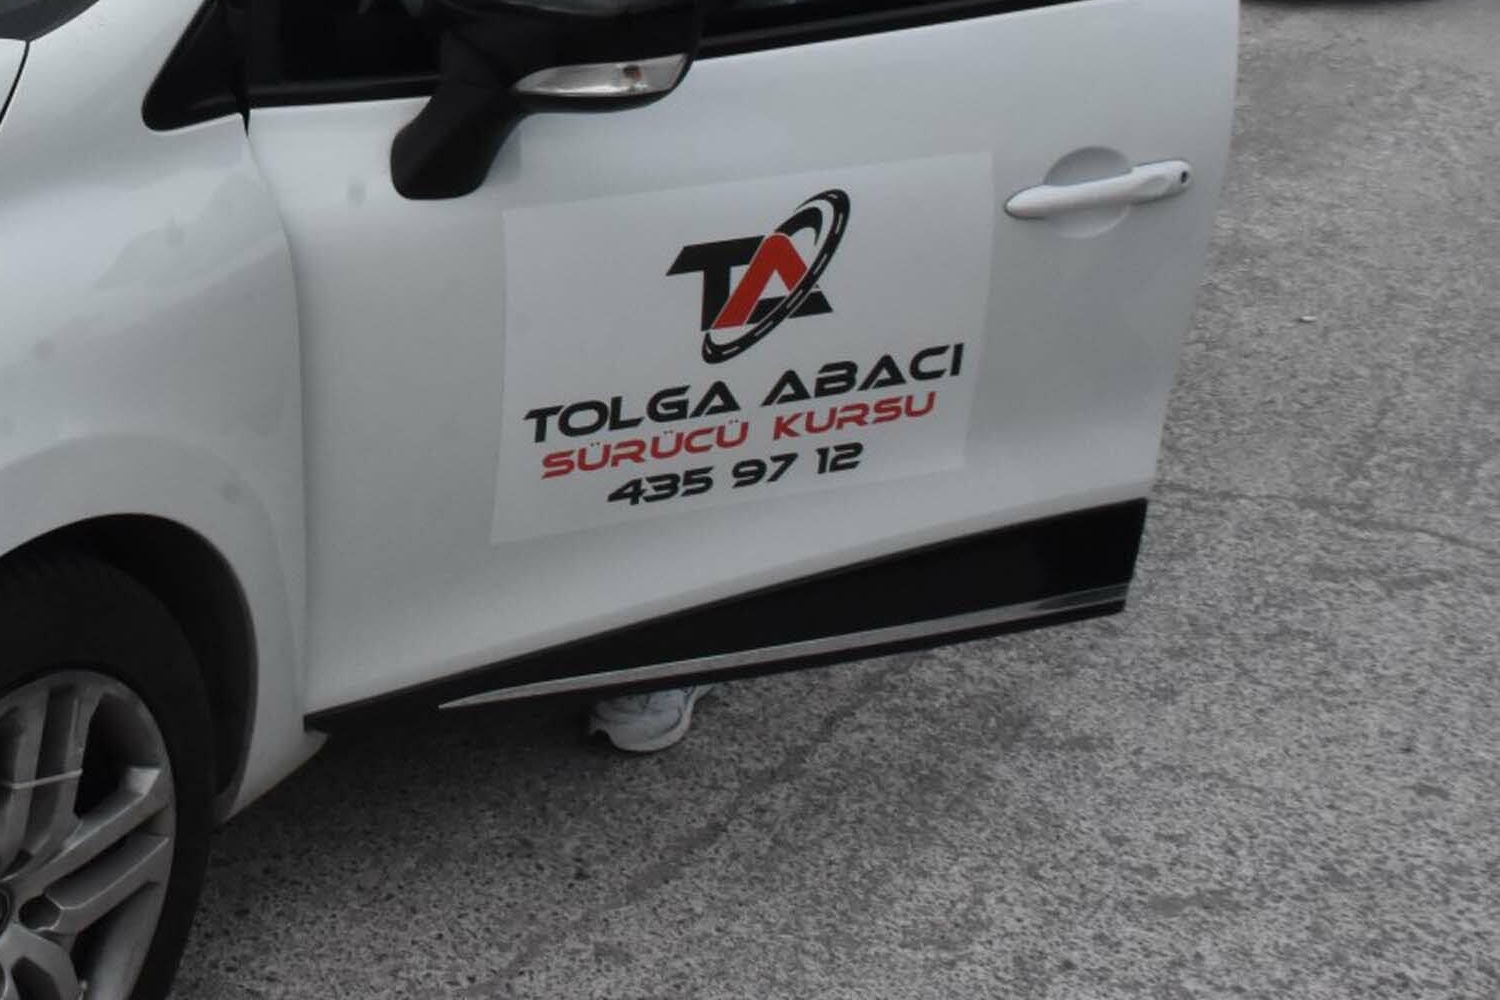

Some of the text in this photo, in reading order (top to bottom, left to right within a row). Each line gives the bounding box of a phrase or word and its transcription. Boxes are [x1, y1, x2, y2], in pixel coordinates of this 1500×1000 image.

[524, 343, 965, 443] TOLGA ABACI
[541, 391, 937, 479] SÜRÜCÜ KURSU
[607, 442, 864, 506] 435 97 12
